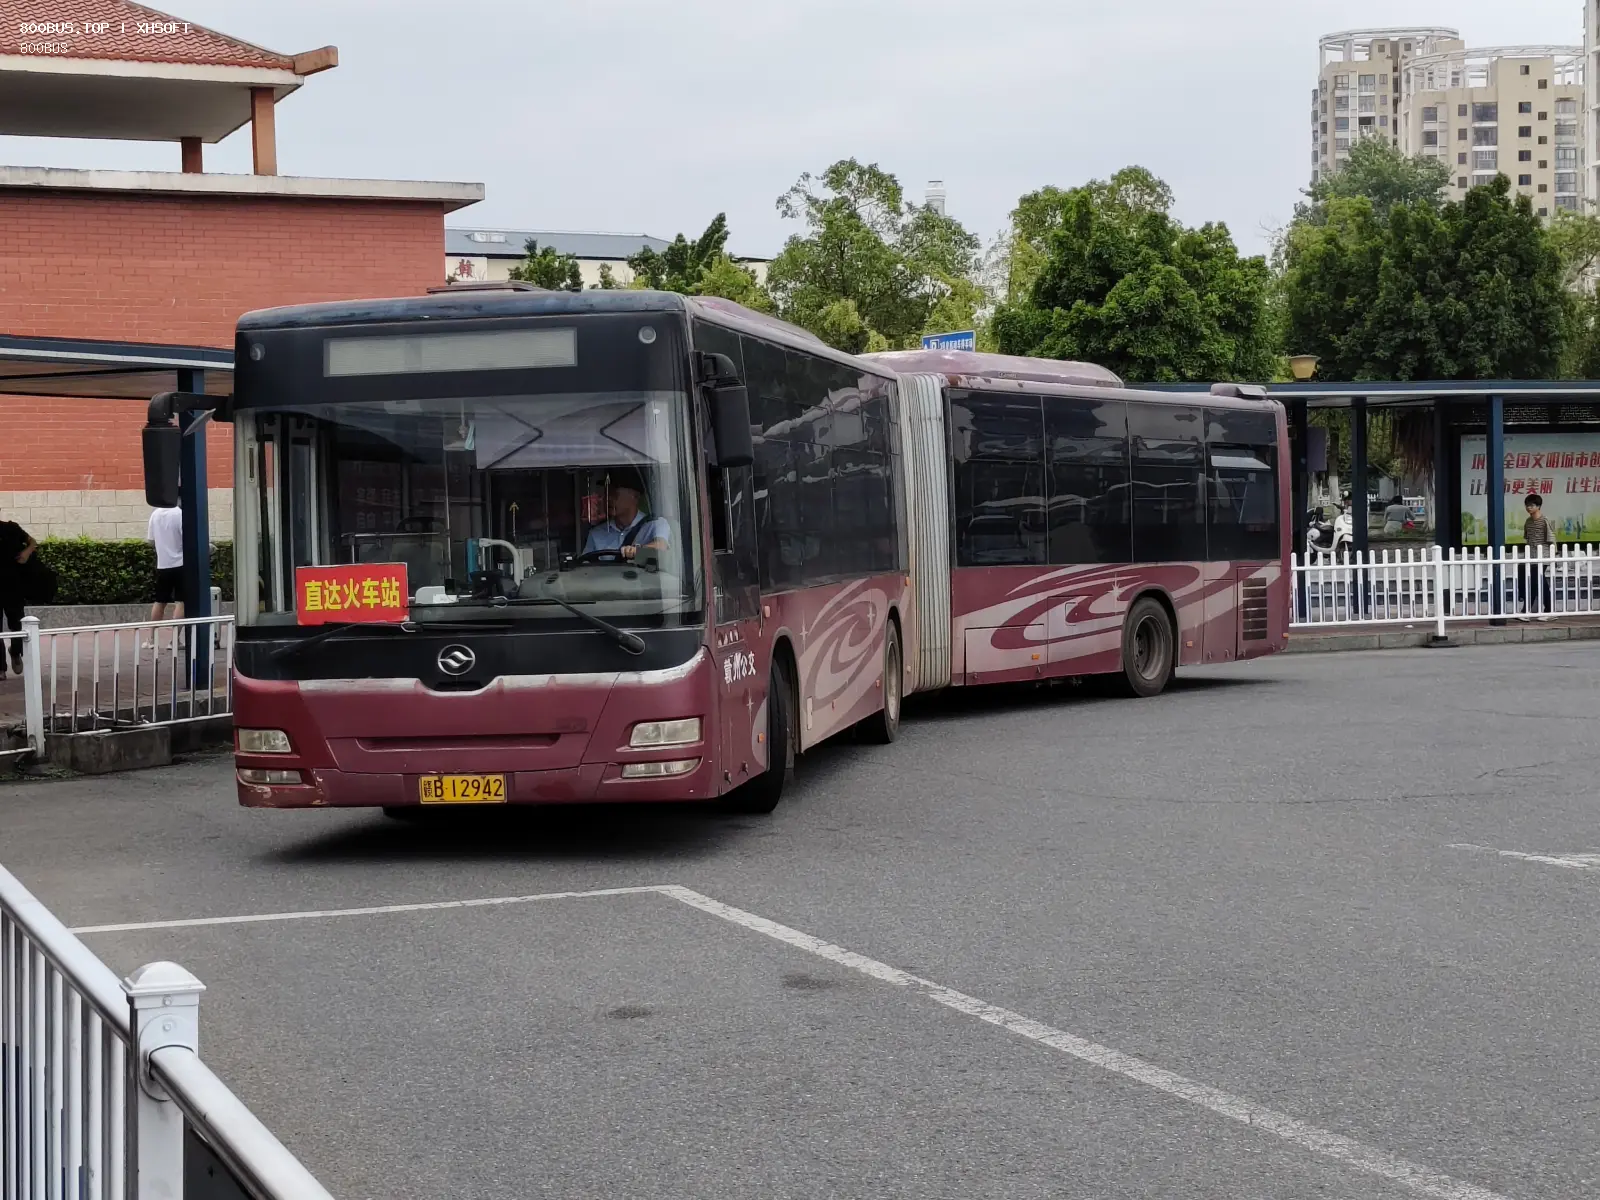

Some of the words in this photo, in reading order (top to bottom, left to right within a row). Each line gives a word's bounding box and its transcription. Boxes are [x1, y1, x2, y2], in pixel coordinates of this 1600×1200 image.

[304, 576, 401, 611] 直达火车站
